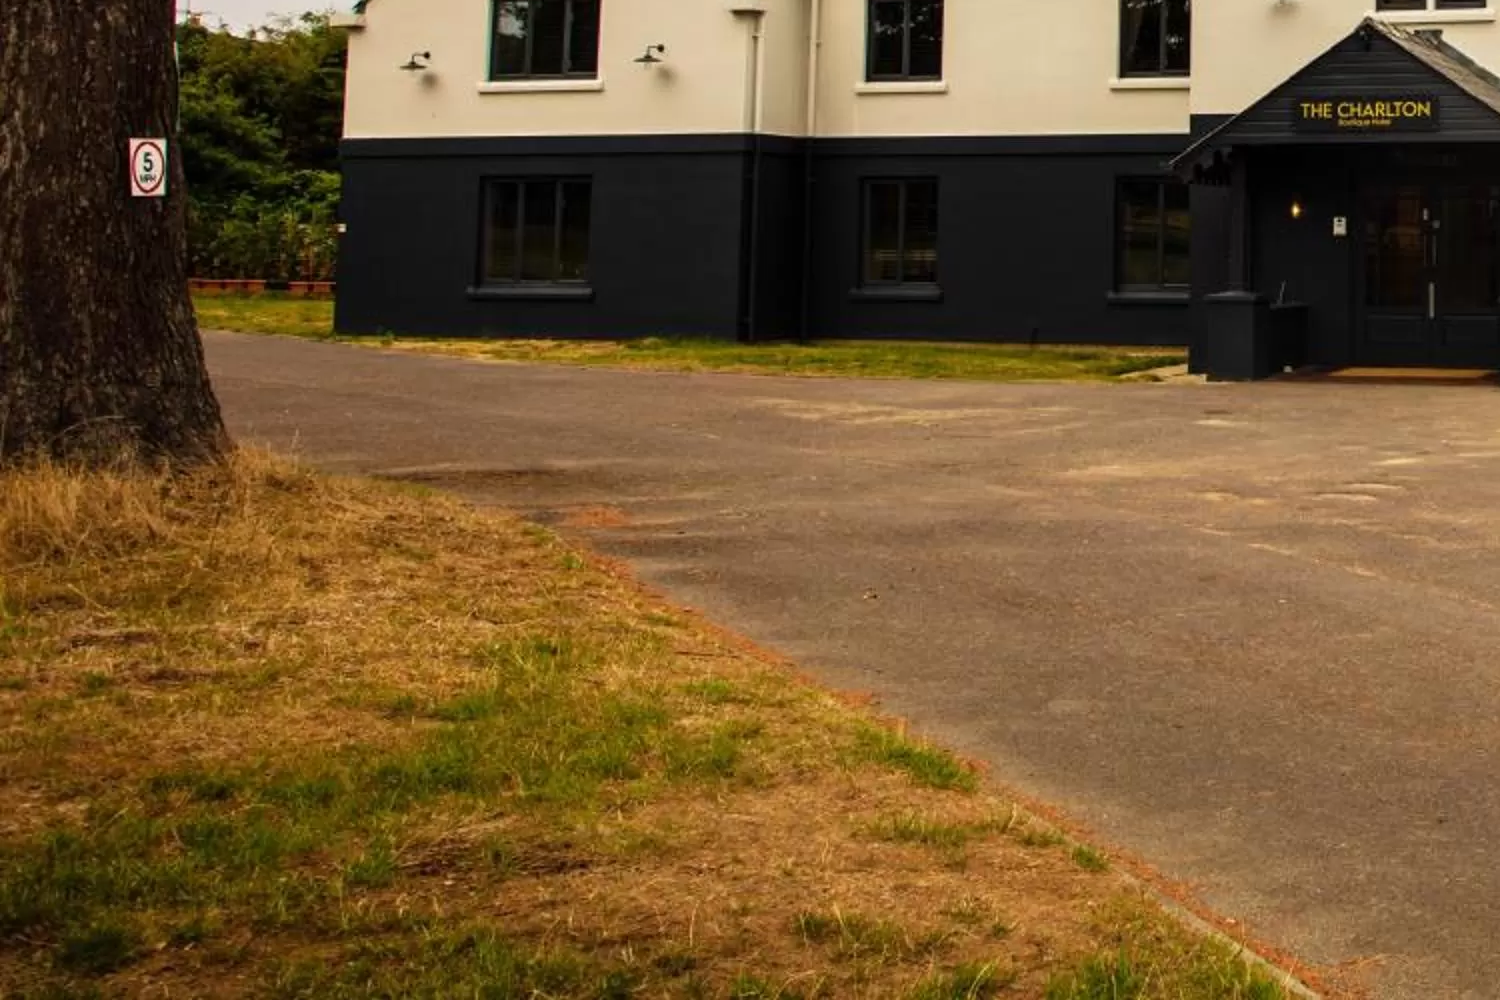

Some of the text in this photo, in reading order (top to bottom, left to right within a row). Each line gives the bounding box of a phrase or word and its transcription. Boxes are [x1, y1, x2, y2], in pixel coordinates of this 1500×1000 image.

[1300, 101, 1431, 119] THE CHARLTON
[143, 151, 153, 172] 5
